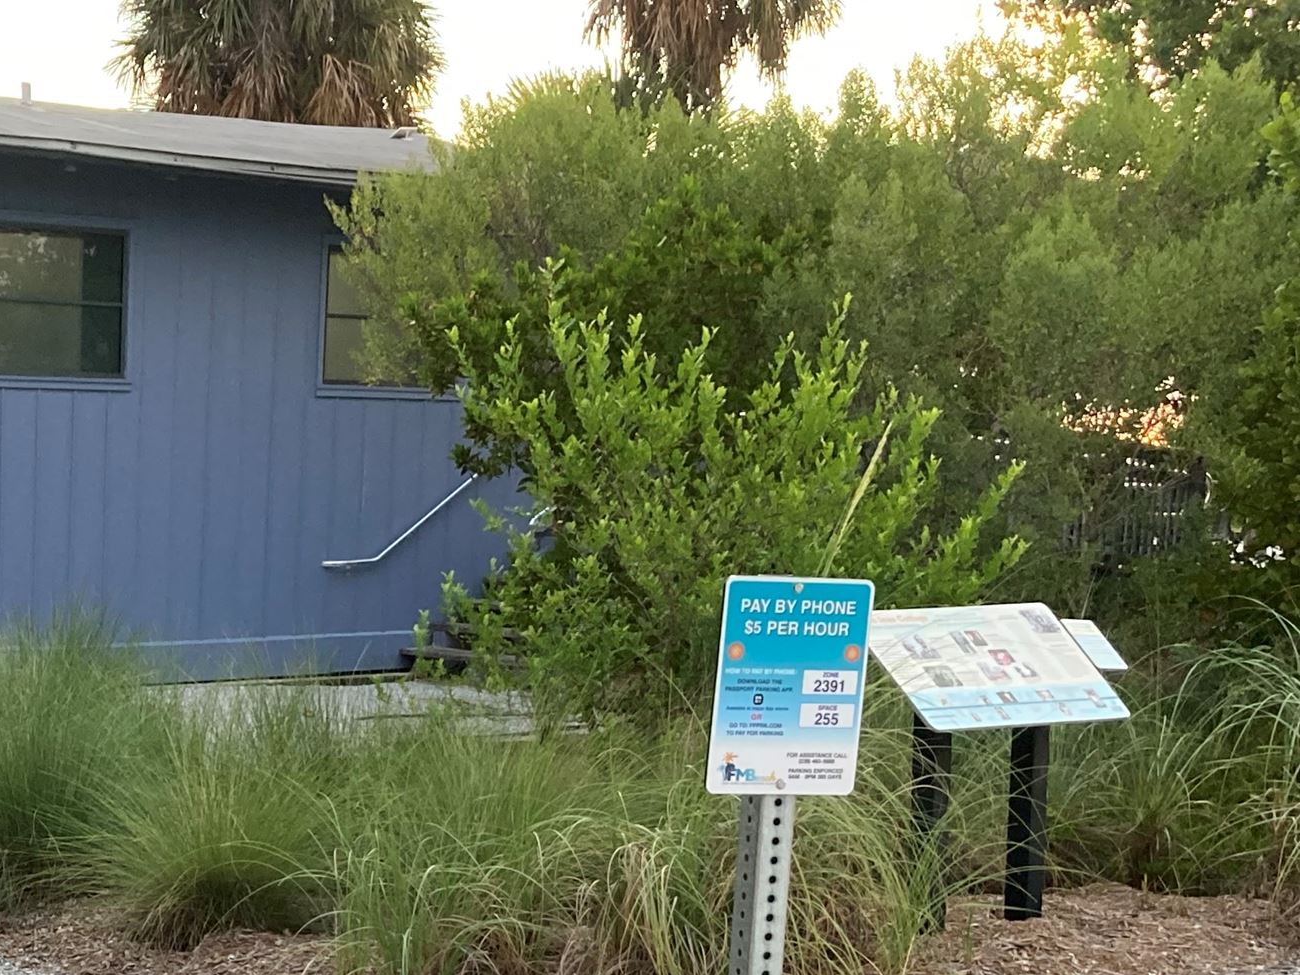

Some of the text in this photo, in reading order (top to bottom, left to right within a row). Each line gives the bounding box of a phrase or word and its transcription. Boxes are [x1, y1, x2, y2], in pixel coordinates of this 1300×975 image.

[740, 598, 857, 615] PAY BY PHONE
[744, 620, 850, 637] $5 PER HOUR
[813, 679, 845, 693] 2391
[814, 712, 839, 726] 255
